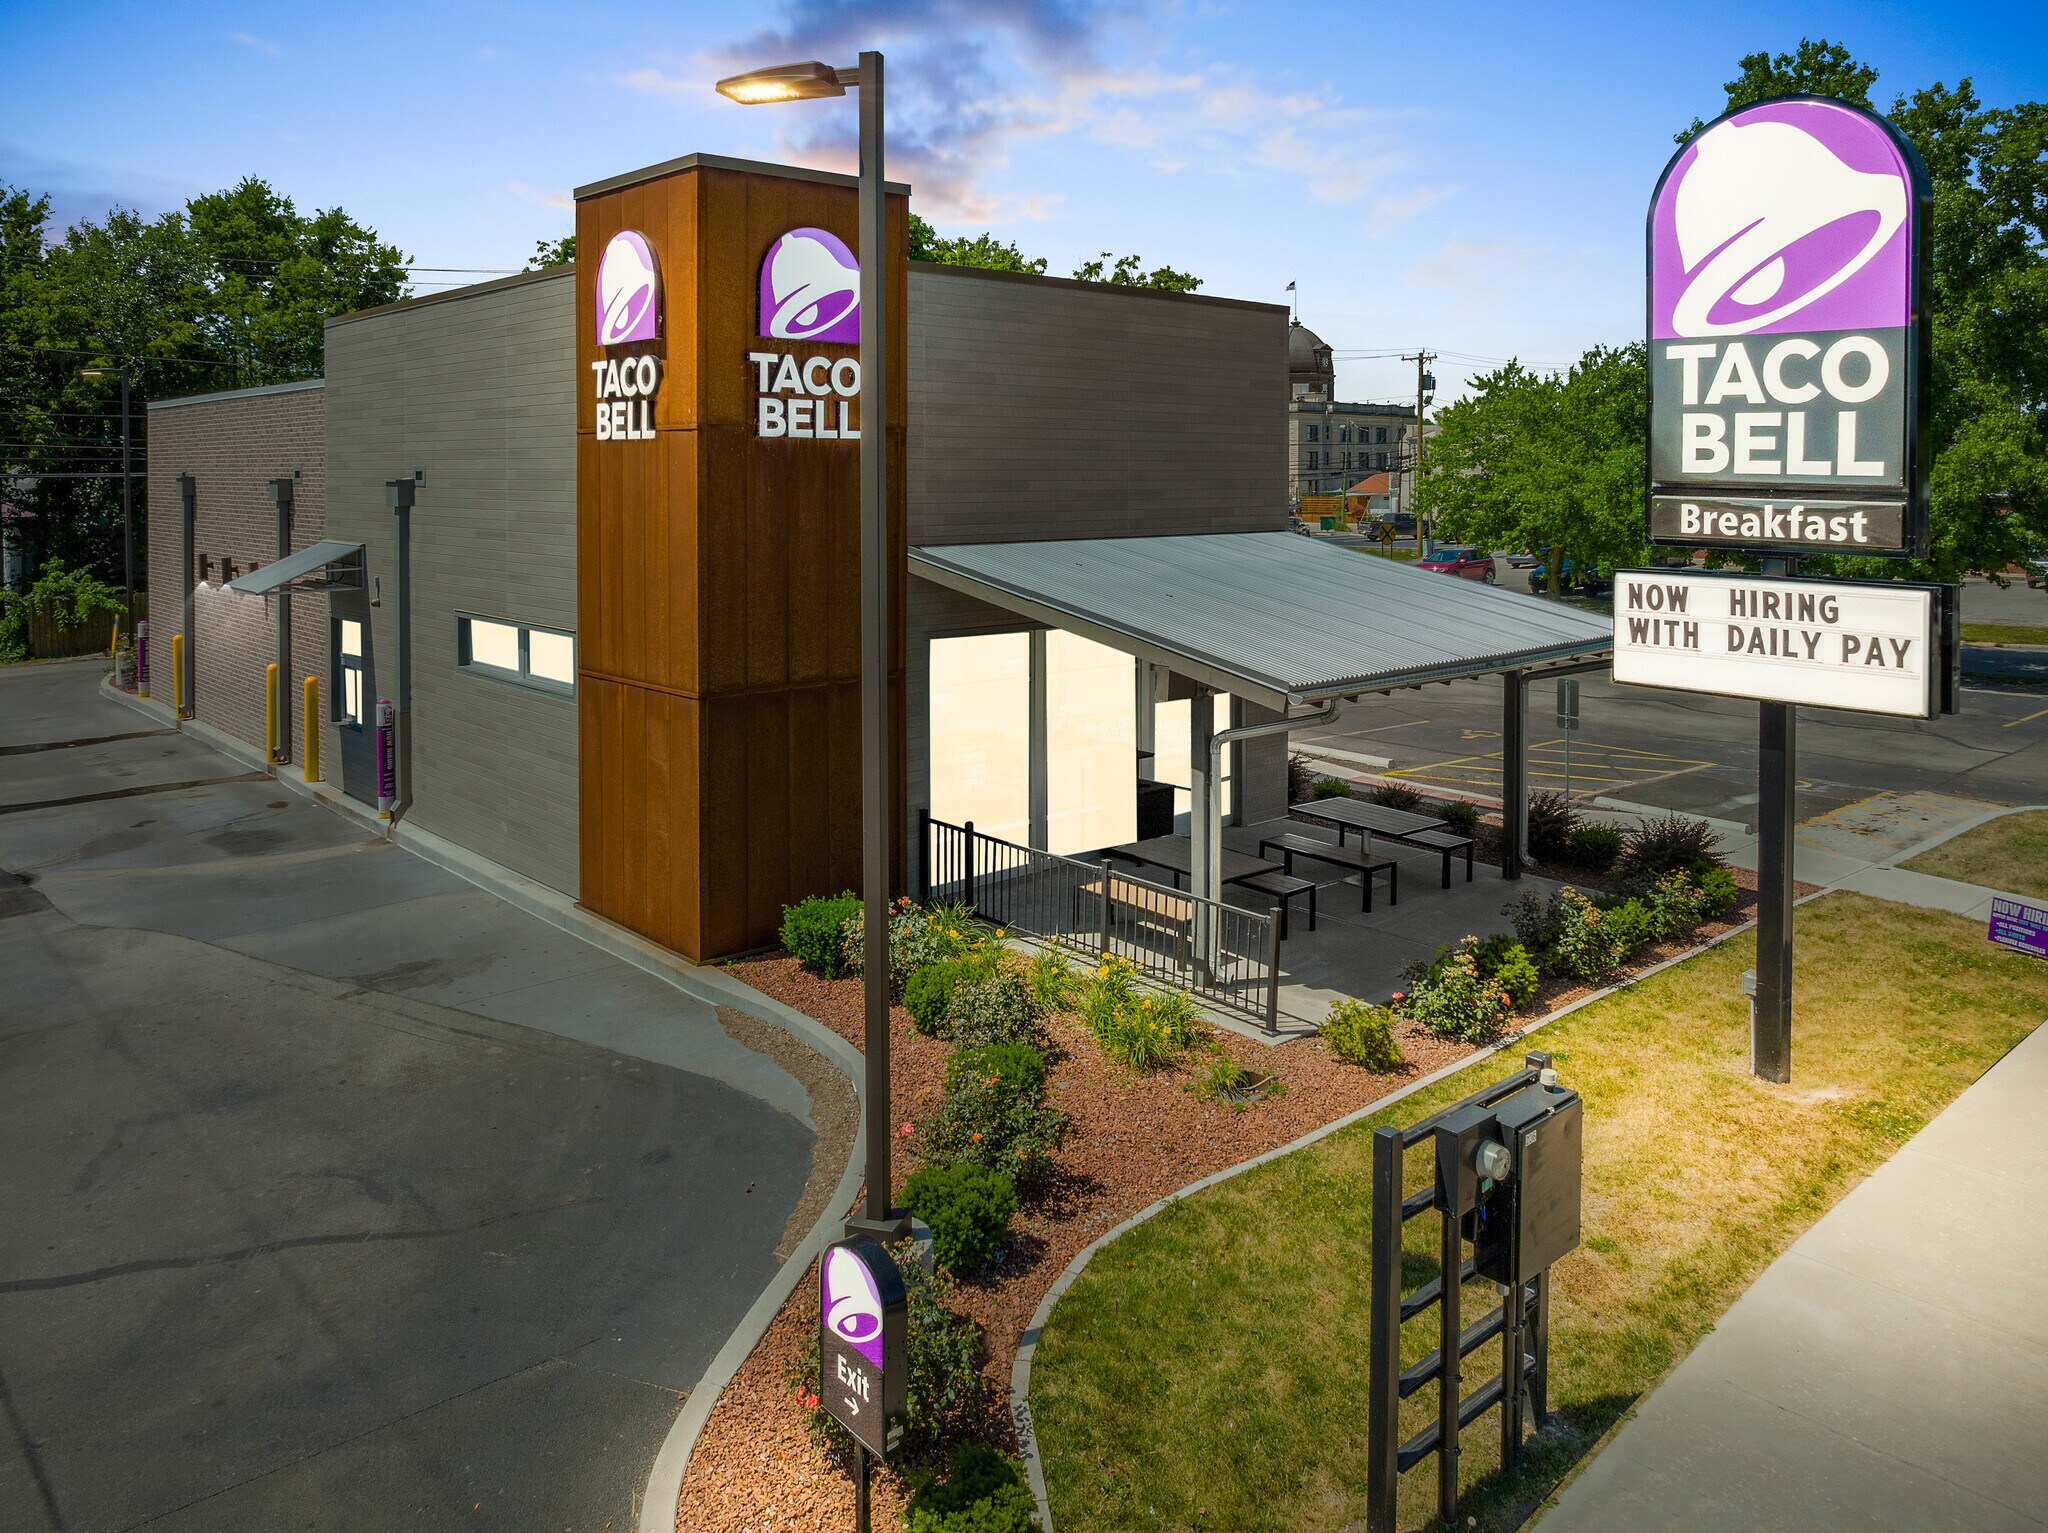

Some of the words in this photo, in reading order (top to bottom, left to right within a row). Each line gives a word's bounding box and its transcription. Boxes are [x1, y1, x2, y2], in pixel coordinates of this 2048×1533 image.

[592, 355, 657, 398] TACO
[750, 352, 860, 396] TACO
[1666, 336, 1890, 405] TACO
[596, 400, 655, 440] BELL
[759, 397, 860, 439] BELL
[1681, 411, 1885, 477] BELL
[1680, 503, 1868, 543] Breakfast
[1628, 583, 1689, 613] NOW
[1729, 588, 1839, 624] HIRING
[1628, 617, 1699, 649] WITH
[1728, 624, 1822, 660] DAILY
[1842, 634, 1911, 669] PAY
[963, 751, 985, 765] DRIVE
[964, 764, 985, 777] THRU
[963, 776, 985, 792] OPEN
[1993, 899, 2021, 917] NOW
[2023, 907, 2048, 926] HIRI
[837, 1353, 870, 1402] Exit
